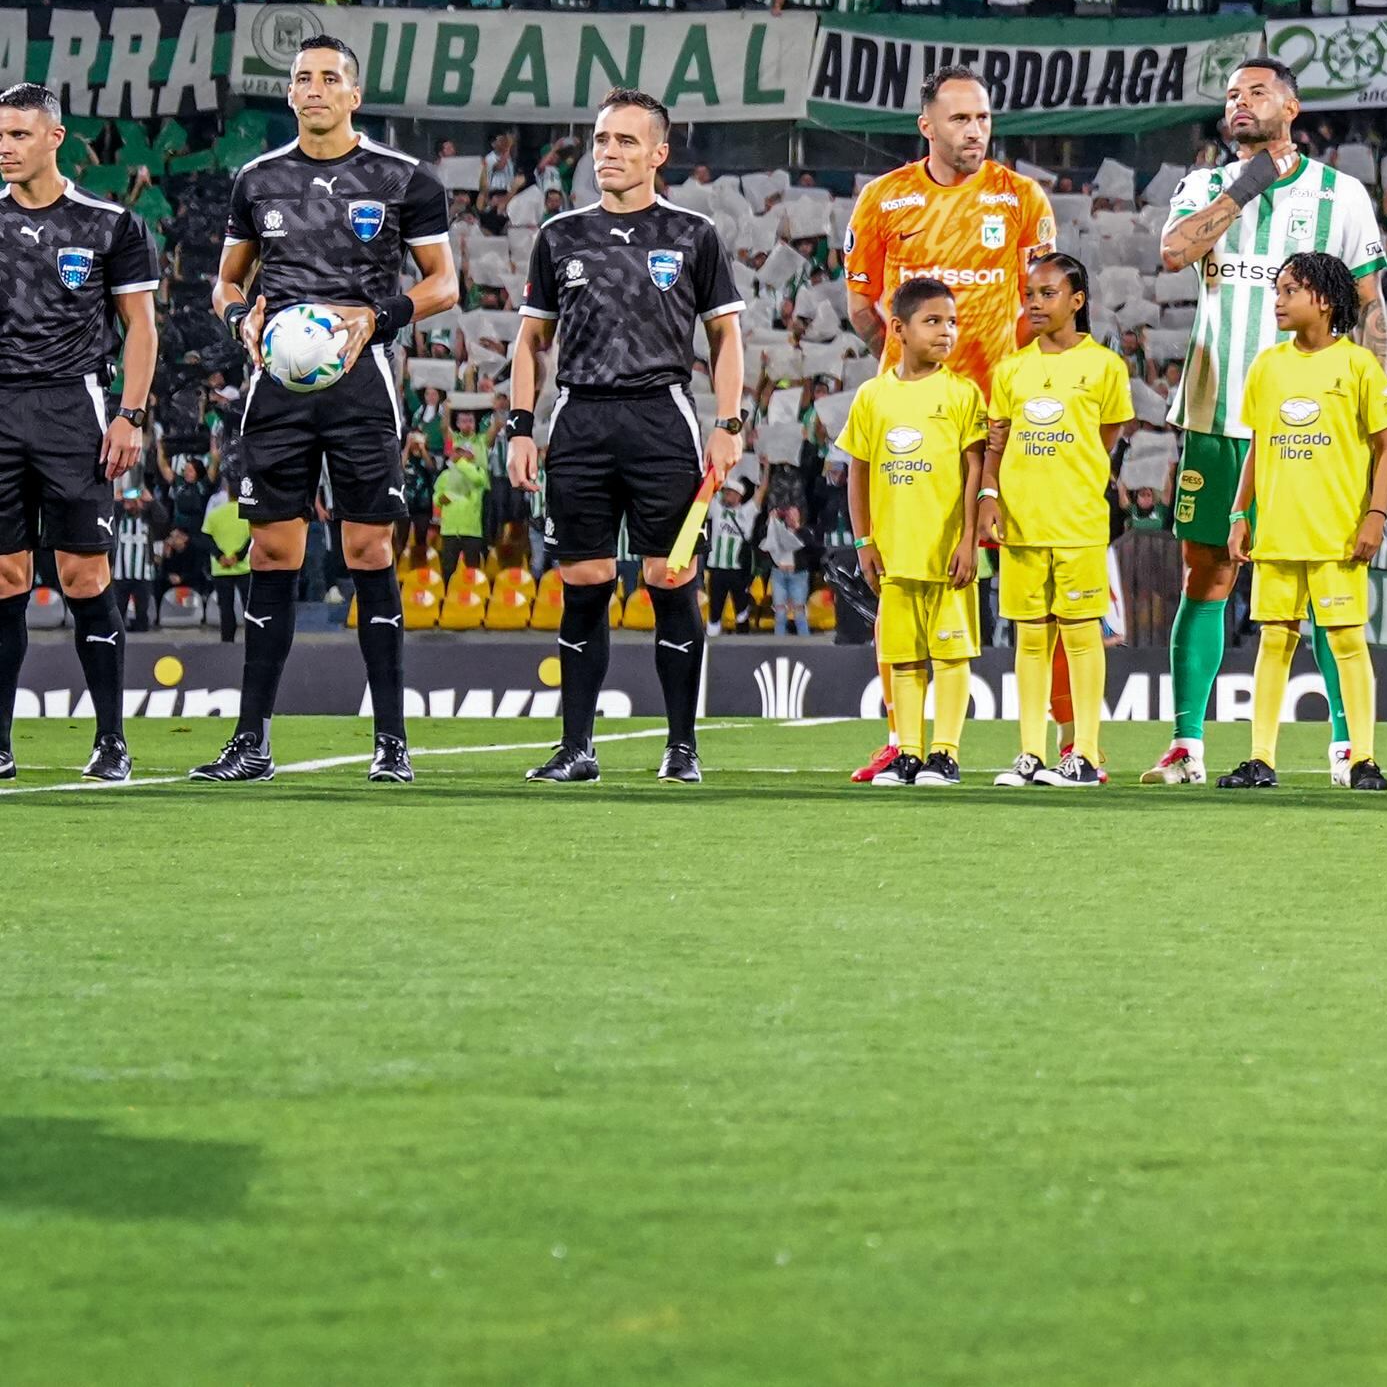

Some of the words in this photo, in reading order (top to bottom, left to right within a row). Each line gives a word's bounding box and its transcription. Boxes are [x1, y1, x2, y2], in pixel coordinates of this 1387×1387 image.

[362, 21, 787, 108] UBANAL
[811, 32, 912, 110] ADN
[1206, 257, 1280, 280] betss
[1015, 430, 1075, 444] mercado
[1269, 432, 1332, 447] mercado
[1024, 443, 1057, 457] libre
[1280, 446, 1313, 460] libre
